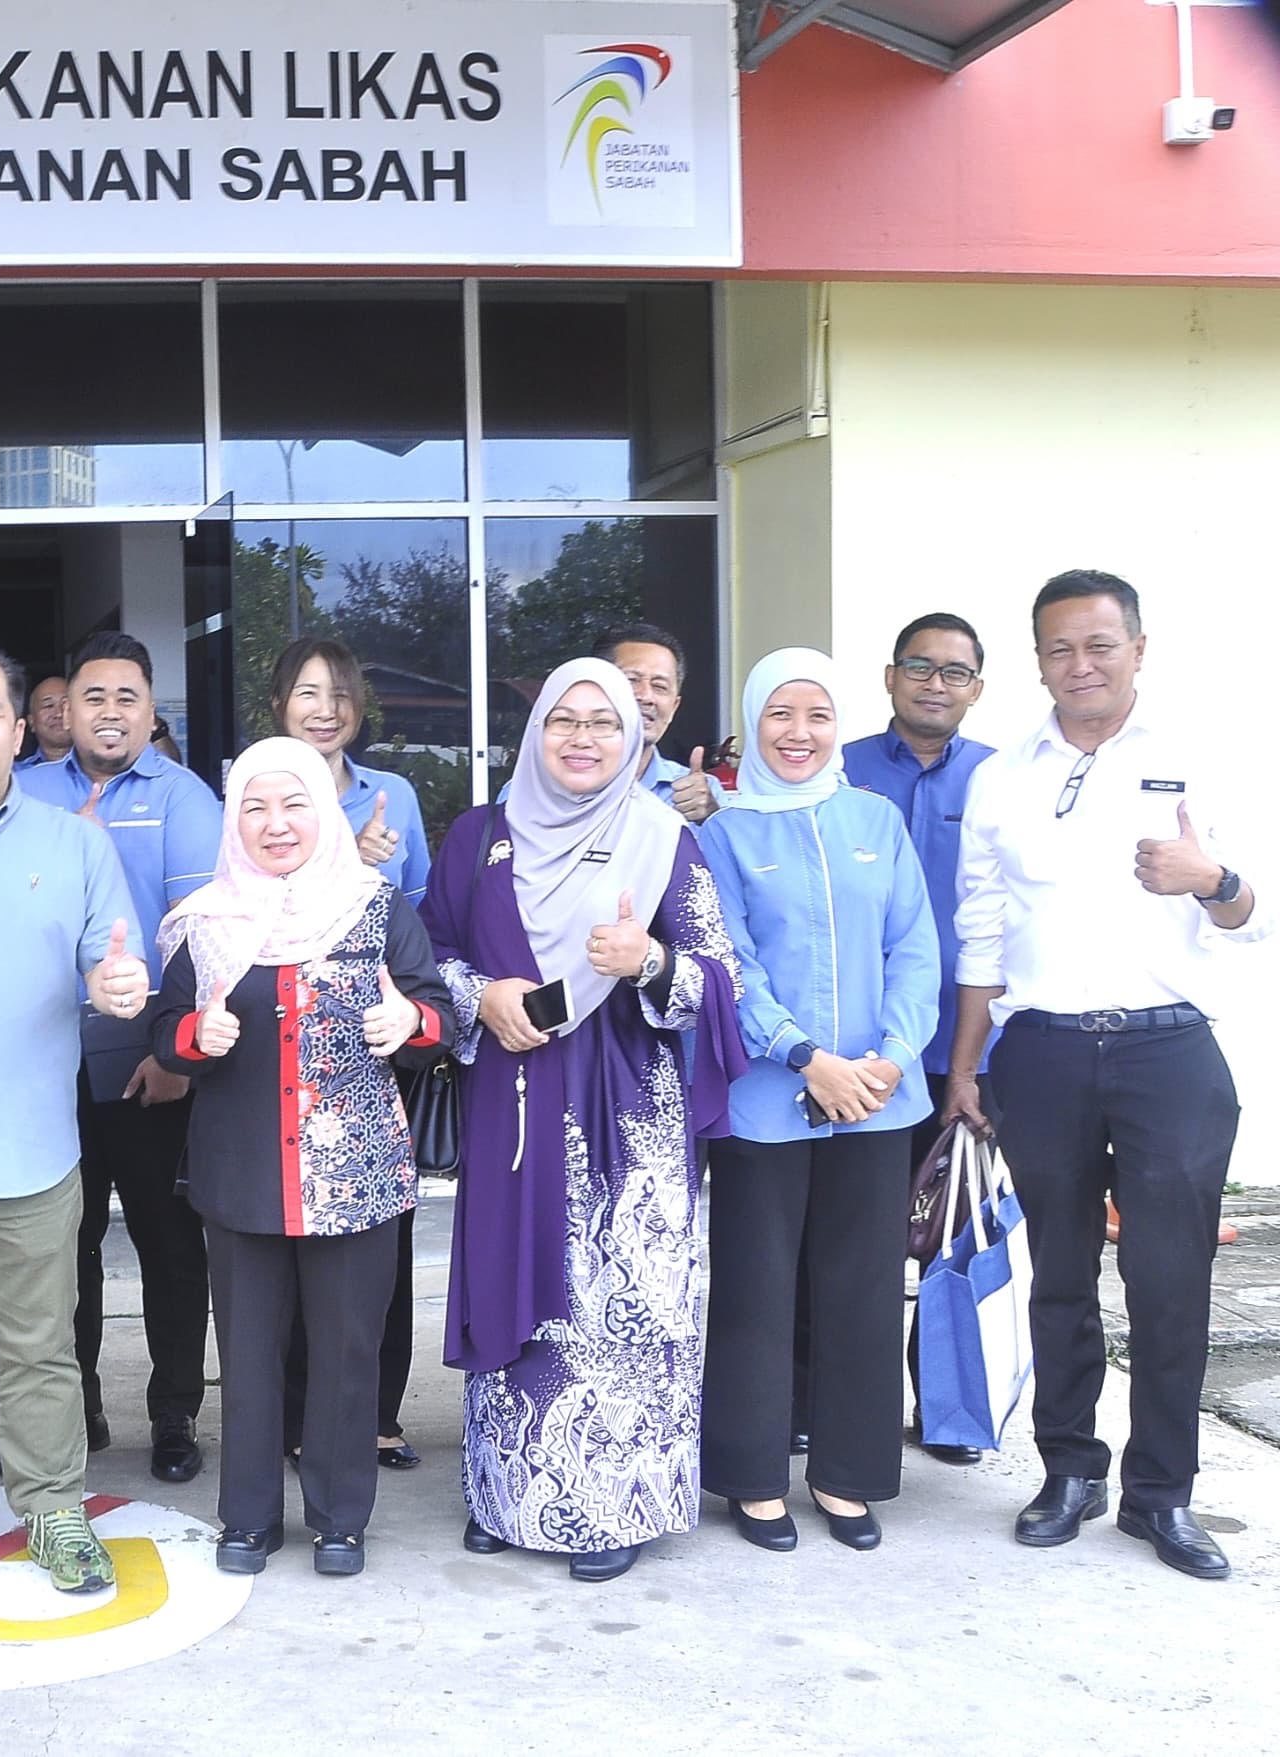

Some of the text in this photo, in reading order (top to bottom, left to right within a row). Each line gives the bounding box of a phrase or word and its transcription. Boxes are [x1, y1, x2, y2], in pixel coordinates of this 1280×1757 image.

[284, 50, 502, 122] LIKAS
[604, 143, 669, 156] JABATAN
[604, 160, 690, 173] PERIKANAN
[219, 146, 468, 203] SABAH
[604, 176, 657, 189] SABAH
